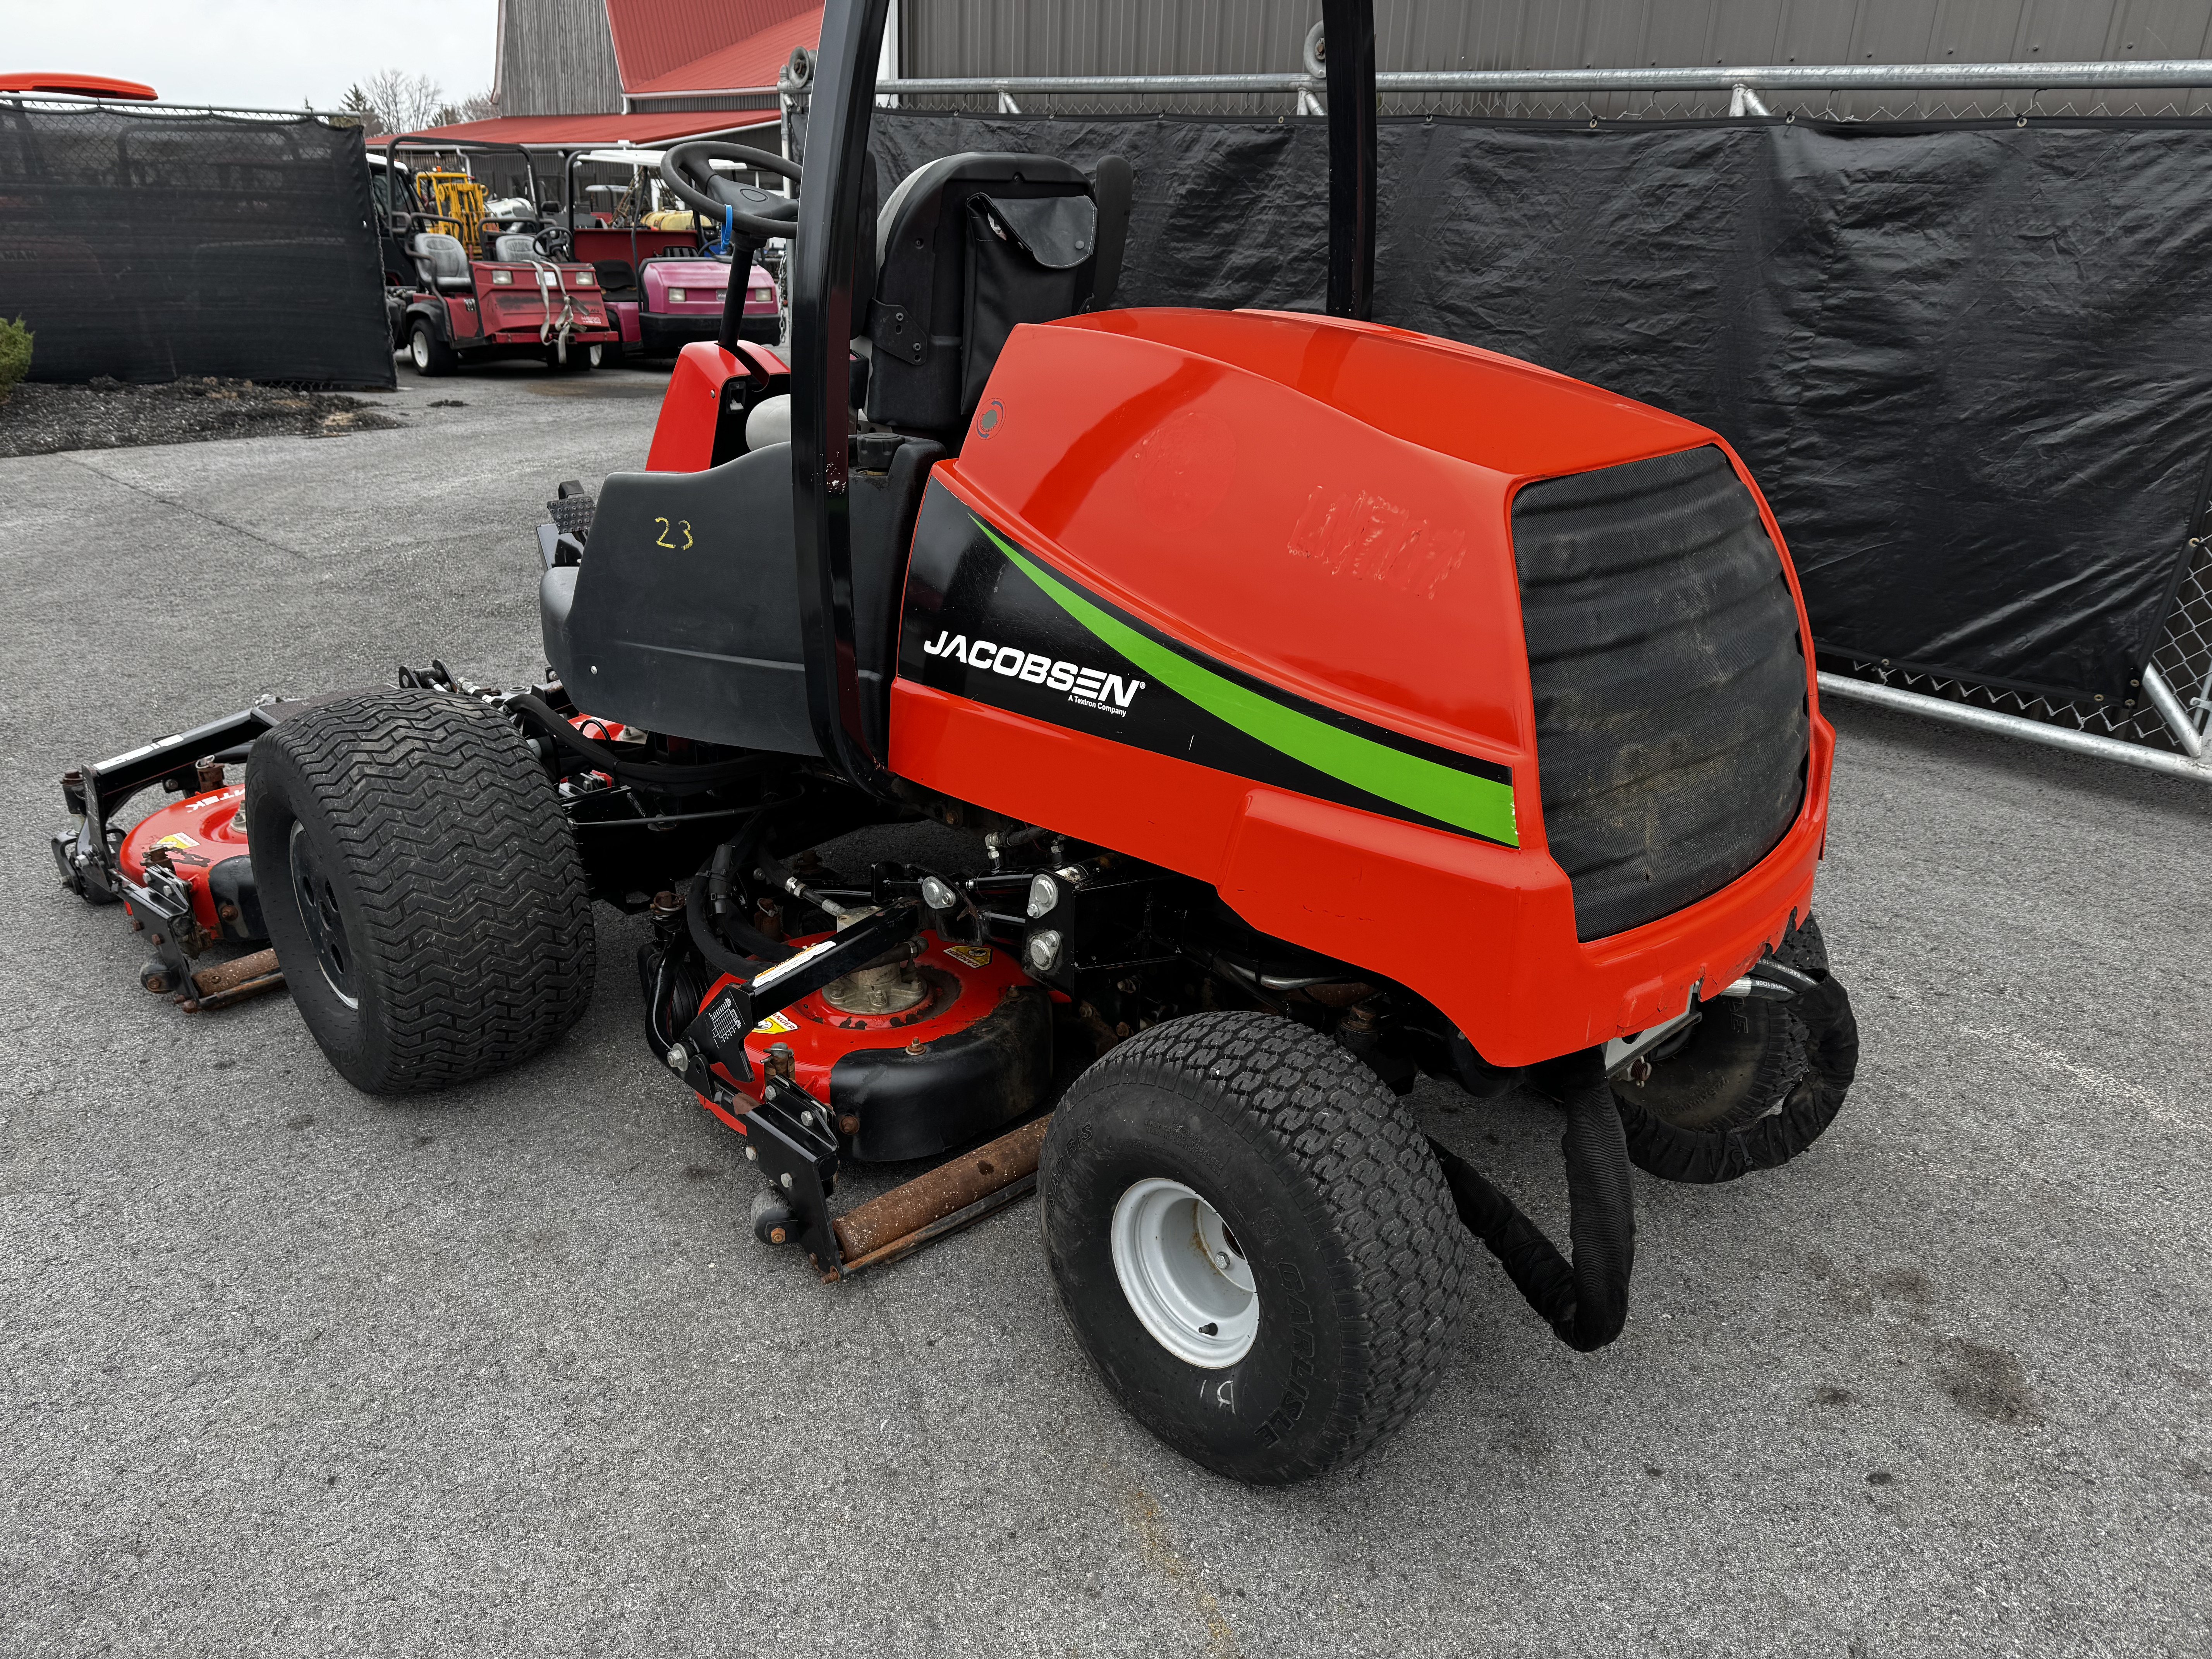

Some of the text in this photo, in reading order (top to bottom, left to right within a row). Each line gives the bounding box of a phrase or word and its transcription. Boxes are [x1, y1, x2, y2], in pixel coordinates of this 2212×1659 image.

[655, 517, 693, 550] 23
[924, 630, 1140, 708] JACOBSEN
[1074, 696, 1096, 708] Textron
[1097, 702, 1127, 718] Company
[947, 950, 979, 967] DANGER
[1192, 1140, 1223, 1169] TUBELESS
[1254, 1262, 1314, 1449] CARLISLE
